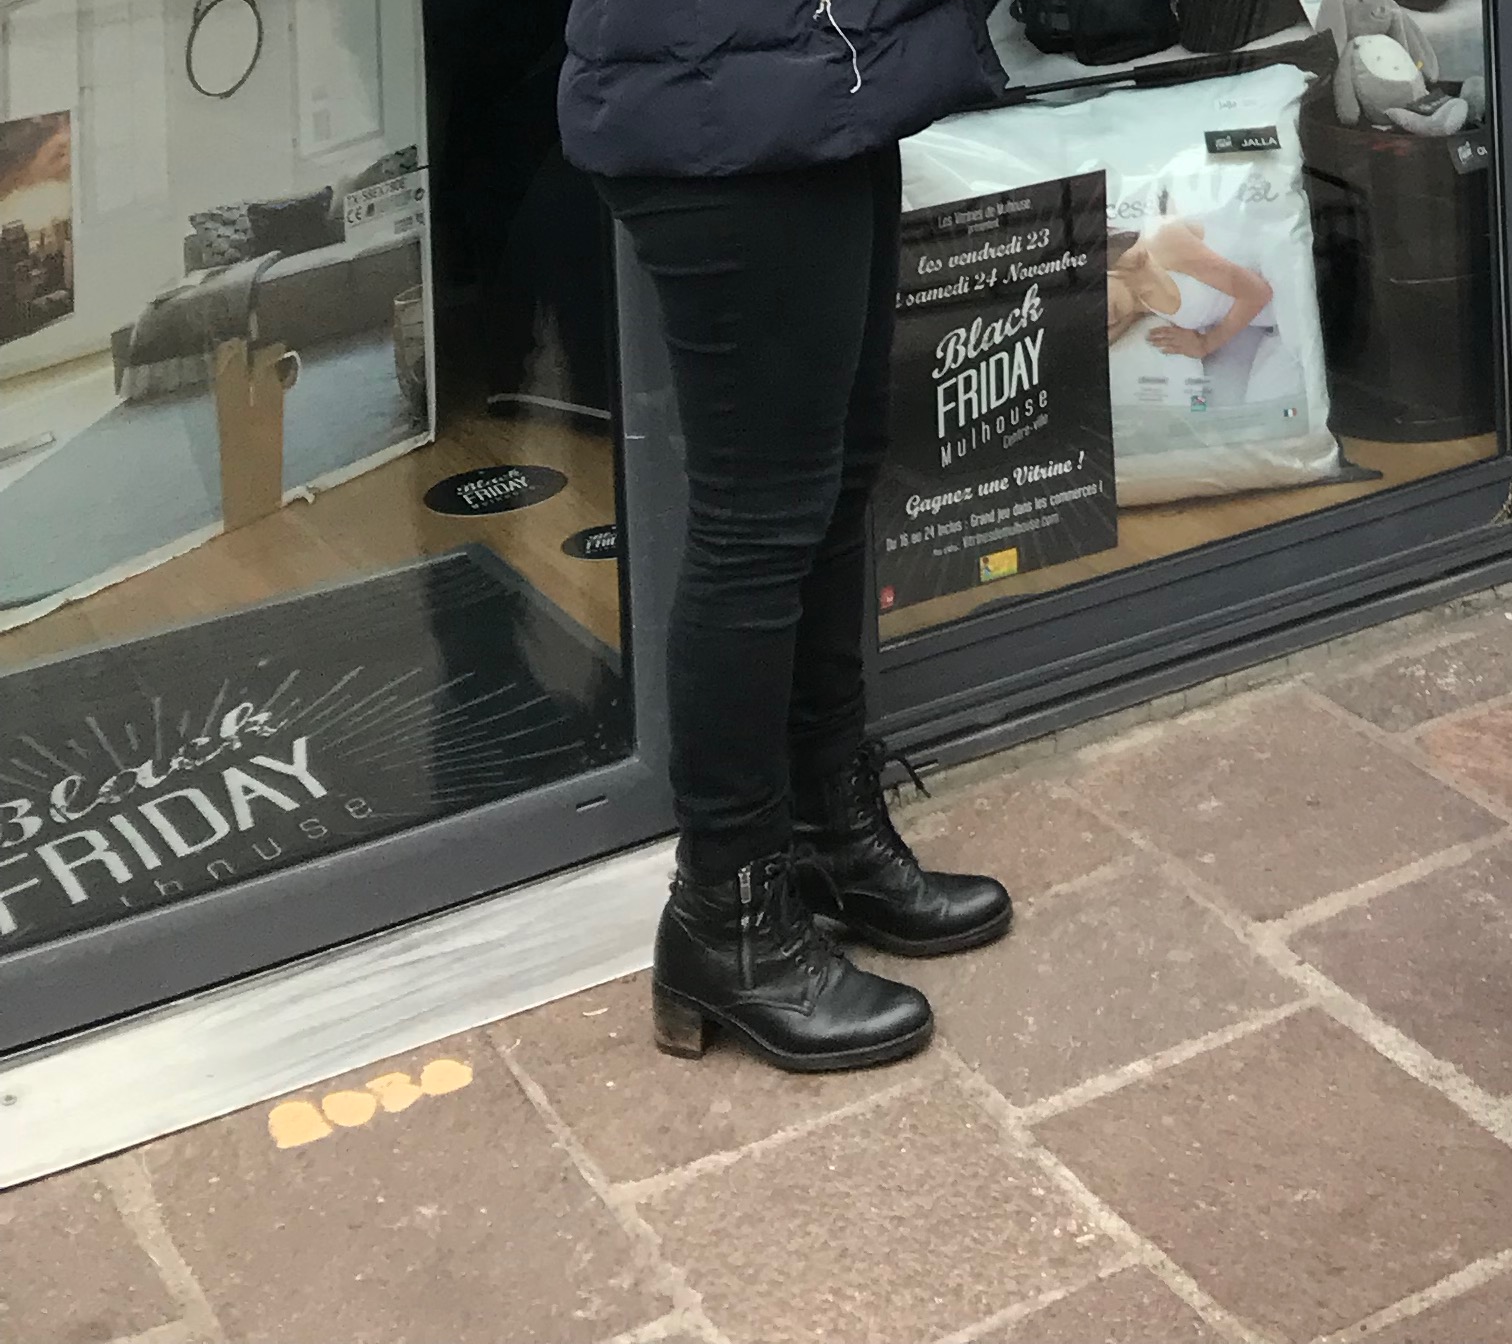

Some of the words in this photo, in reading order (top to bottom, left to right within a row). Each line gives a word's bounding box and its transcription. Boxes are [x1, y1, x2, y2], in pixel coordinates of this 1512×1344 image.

[1241, 136, 1278, 148] JALLA
[906, 275, 969, 307] samedi
[974, 267, 997, 291] 24
[1002, 250, 1087, 284] Novembre
[948, 235, 1022, 268] vendredi
[1027, 228, 1050, 251] 23
[932, 283, 1044, 379] Black
[936, 327, 1046, 438] FRIDAY
[940, 390, 1048, 468] Mulhouse
[462, 476, 530, 506] FRIDAY
[906, 487, 973, 520] Gagnez
[978, 477, 1010, 497] une
[1012, 460, 1073, 486] Vitrine
[1077, 450, 1085, 470] !
